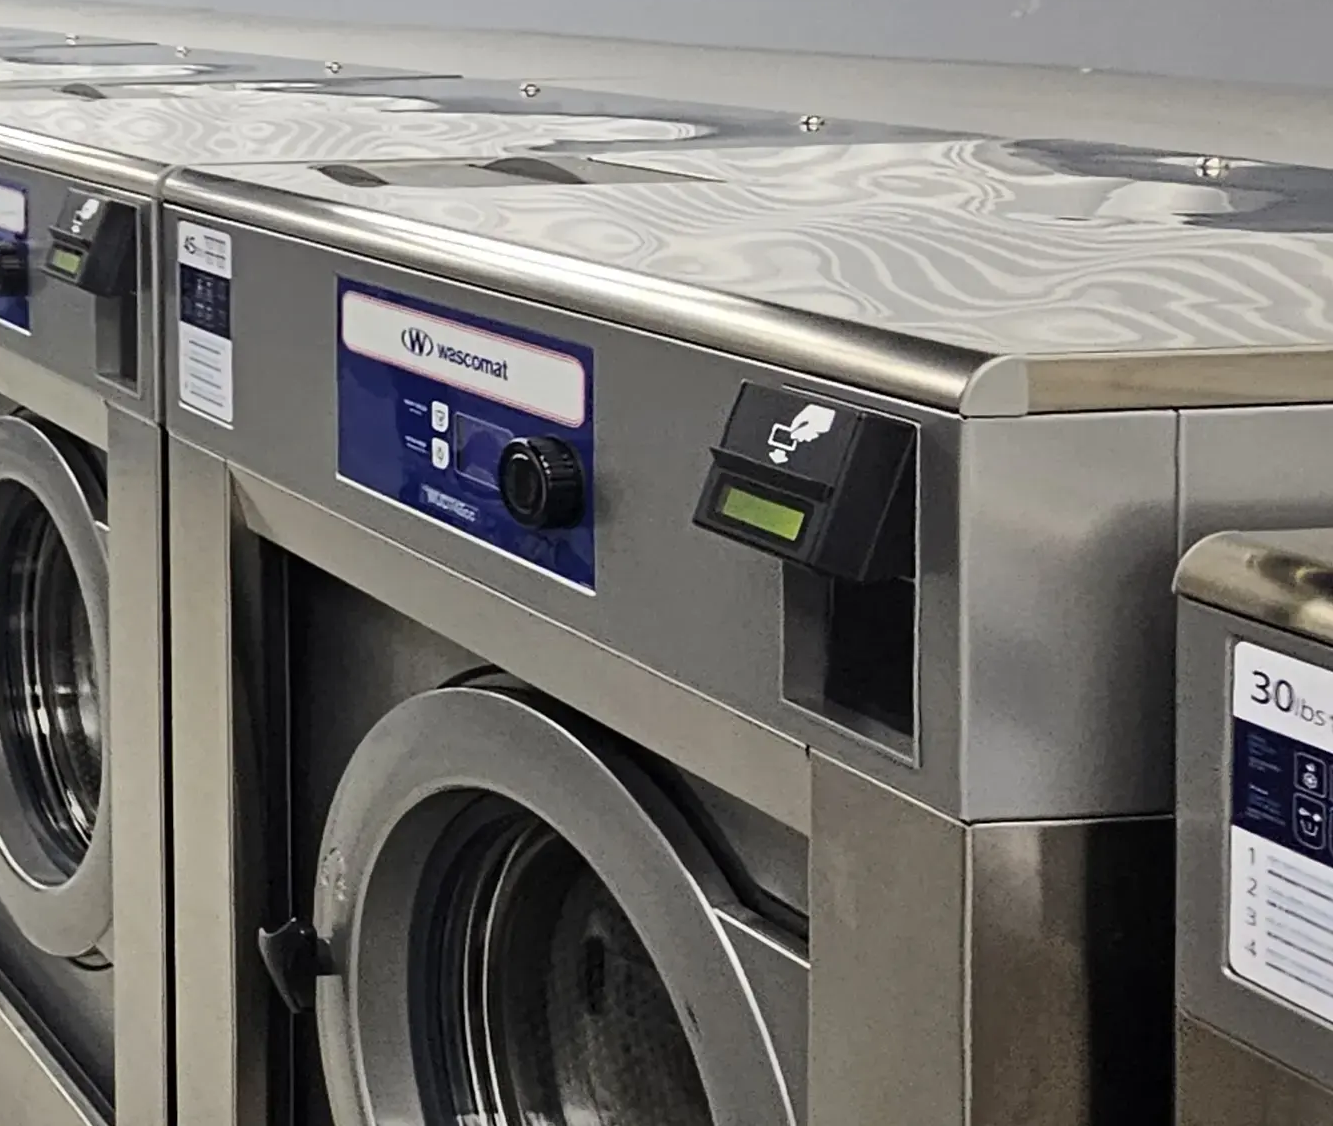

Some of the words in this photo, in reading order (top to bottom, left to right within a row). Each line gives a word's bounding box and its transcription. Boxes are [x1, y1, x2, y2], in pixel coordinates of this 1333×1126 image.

[436, 342, 508, 381] wascomat
[1248, 846, 1255, 865] 1
[1246, 877, 1258, 897] 2
